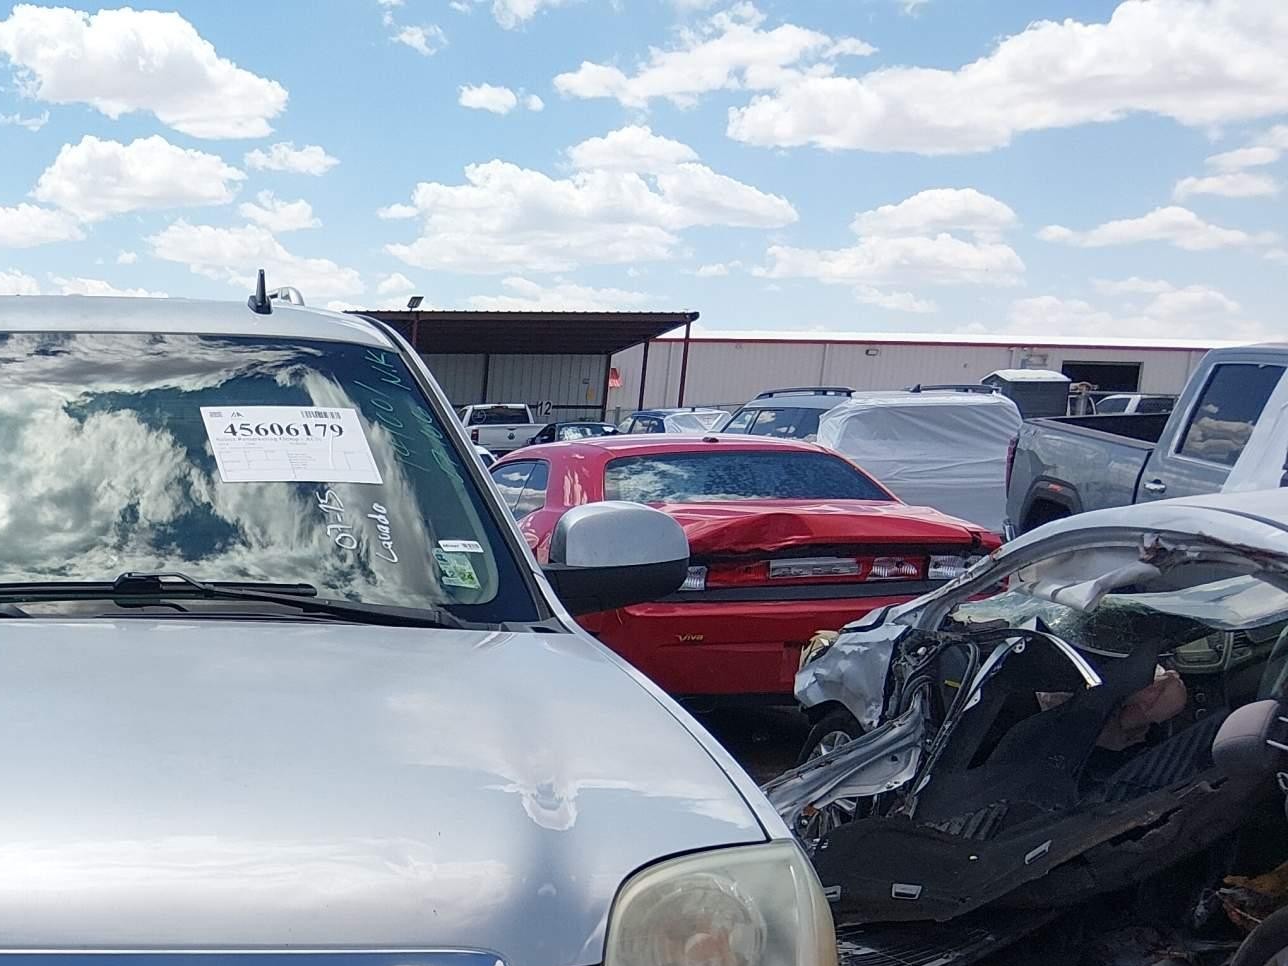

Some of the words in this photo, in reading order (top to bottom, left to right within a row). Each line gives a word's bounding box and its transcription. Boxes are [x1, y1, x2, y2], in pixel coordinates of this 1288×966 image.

[536, 401, 552, 416] 12
[223, 422, 344, 438] 45606179
[316, 488, 358, 550] 07-15
